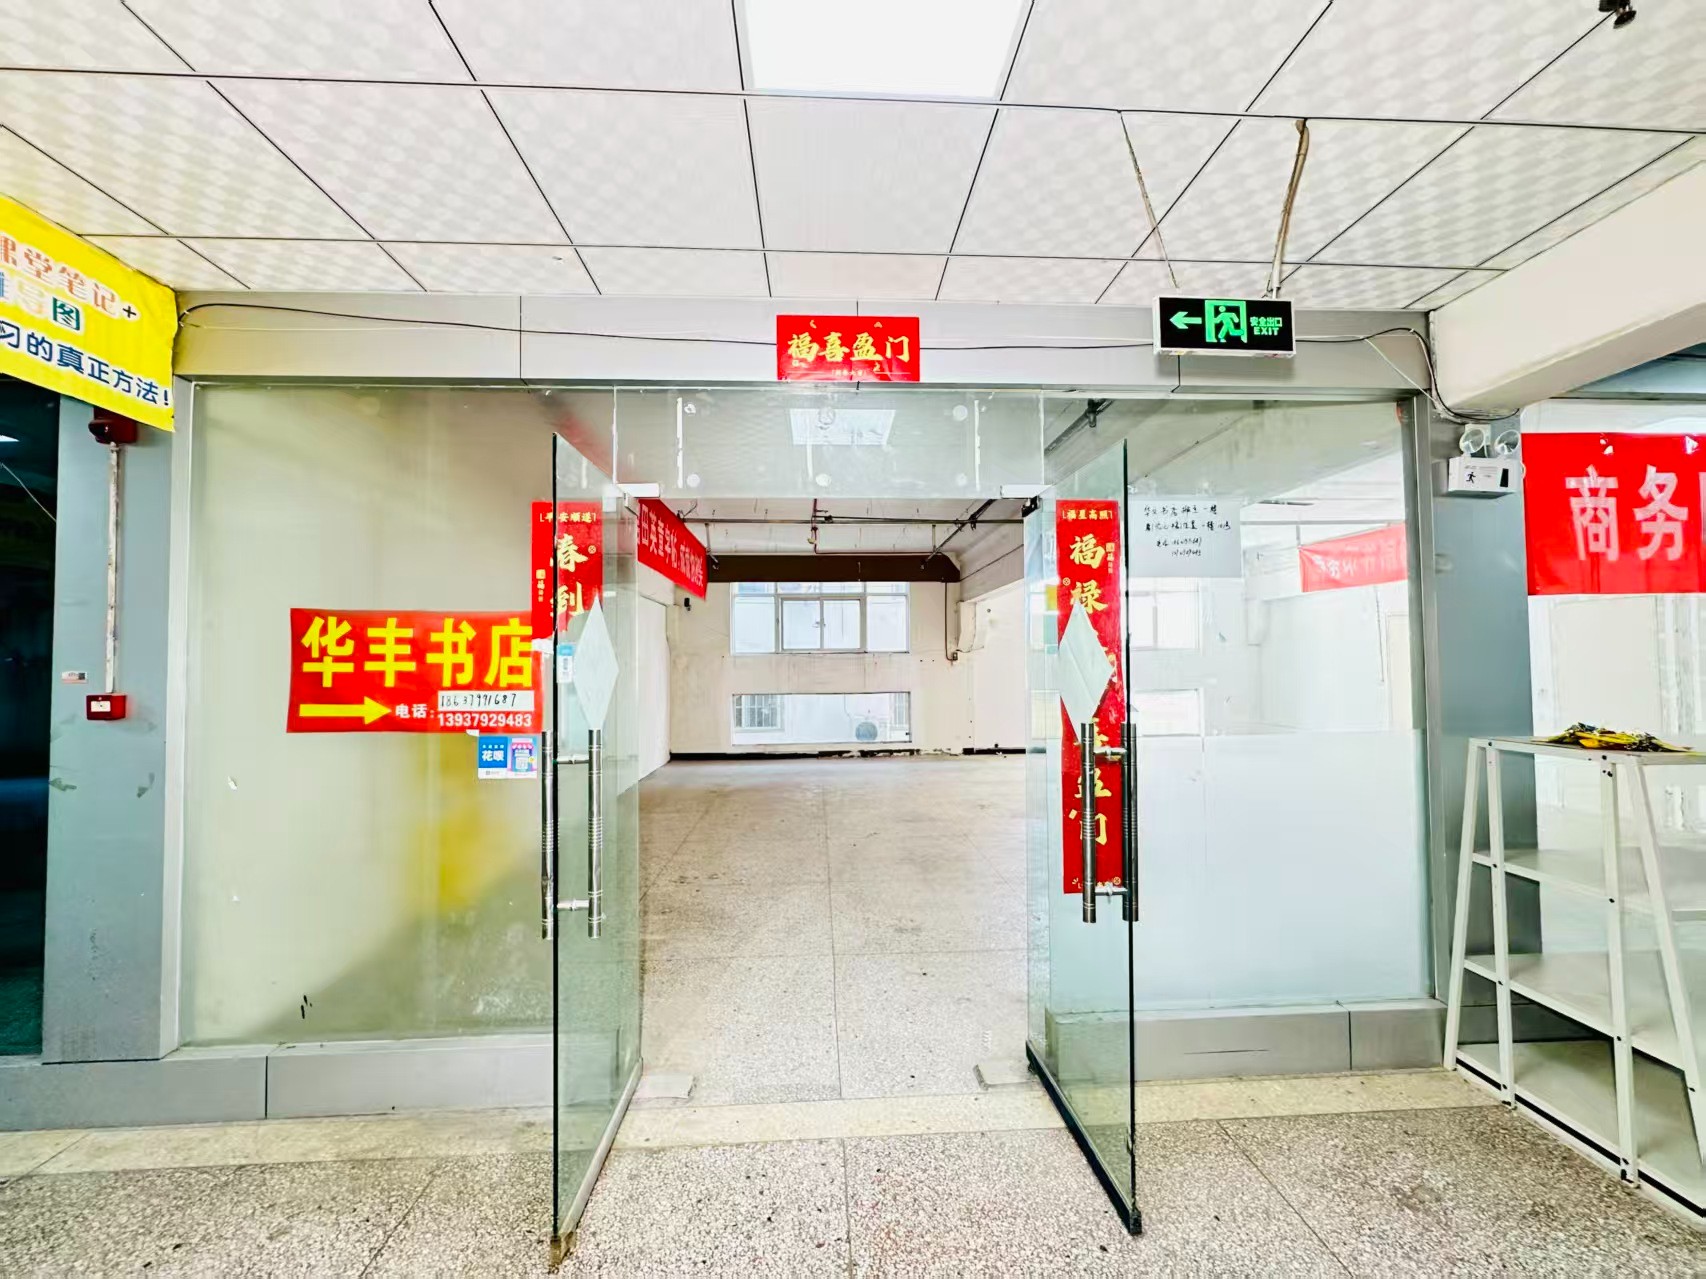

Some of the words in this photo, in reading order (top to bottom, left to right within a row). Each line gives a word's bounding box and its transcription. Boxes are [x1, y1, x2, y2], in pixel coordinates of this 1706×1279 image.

[0, 271, 81, 331] 导图
[1250, 316, 1283, 327] 安全出口
[1254, 327, 1280, 336] EXIT
[787, 331, 910, 363] 福喜盈门
[1565, 464, 1706, 561] 商务
[301, 616, 533, 688] 华丰书店
[441, 693, 517, 707] 18637991687
[438, 712, 533, 727] 13937929483
